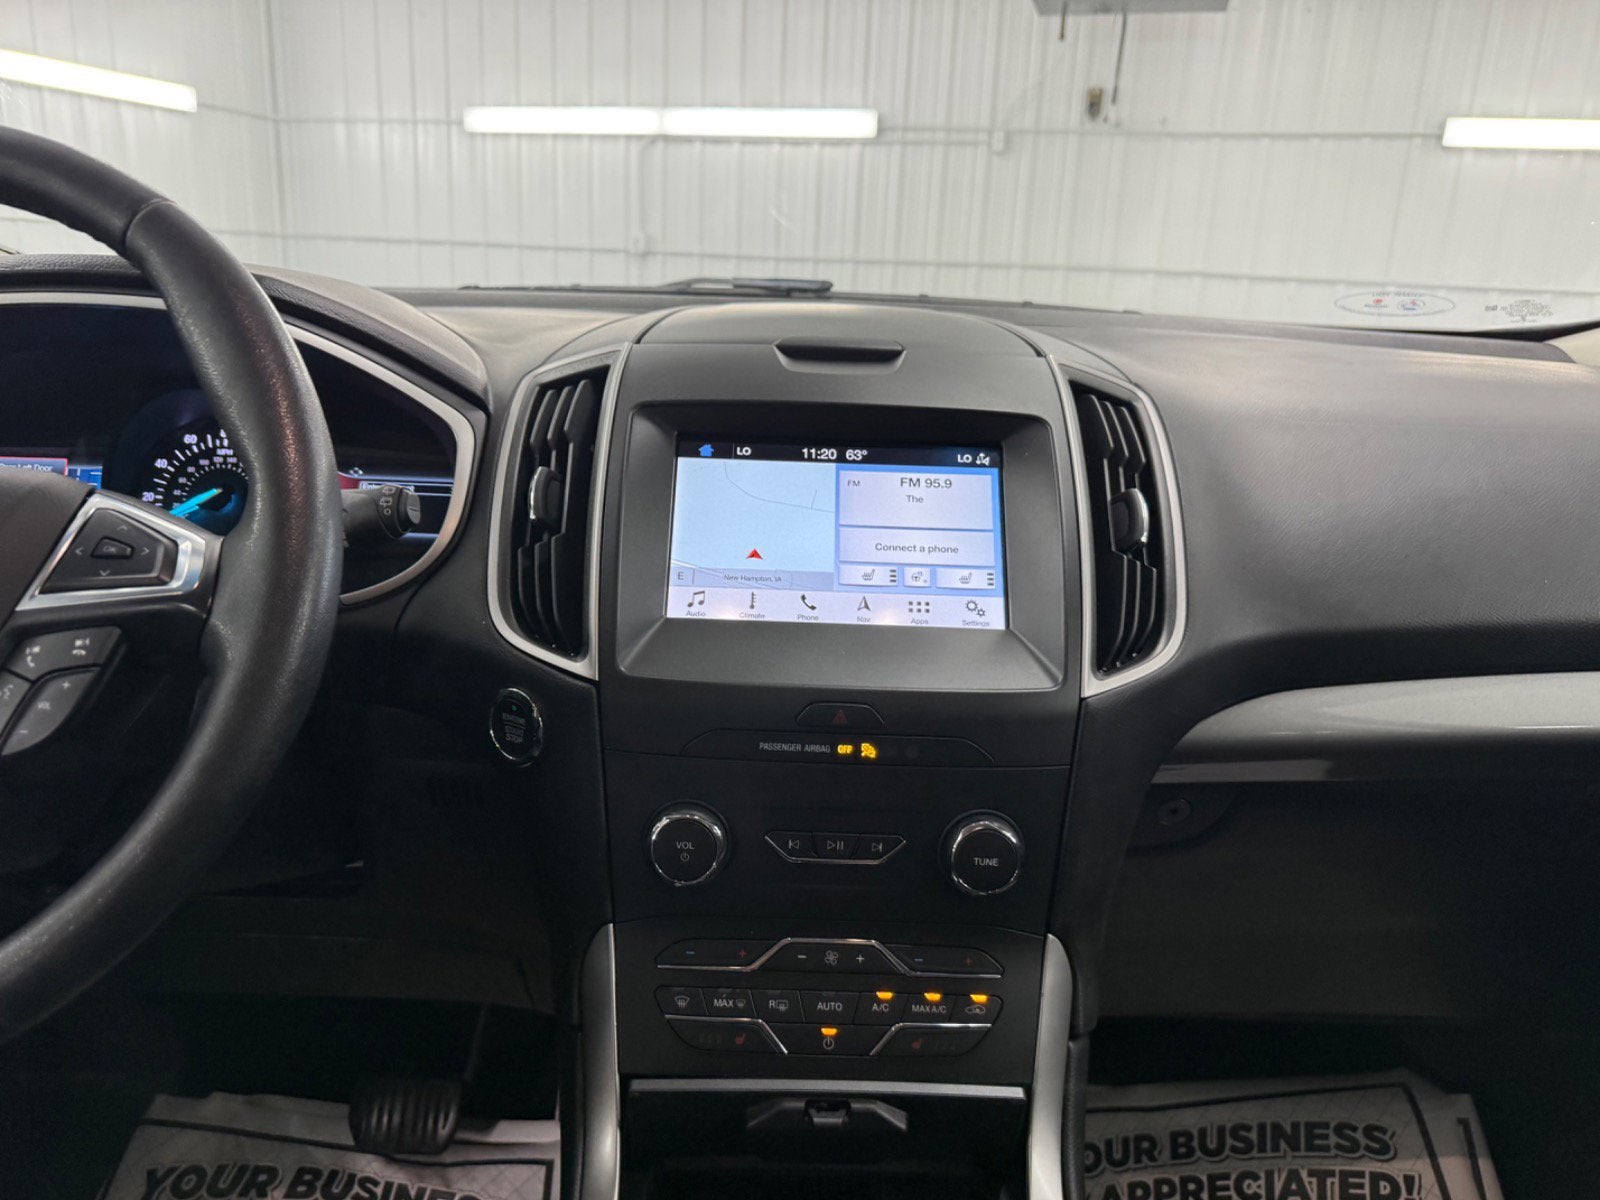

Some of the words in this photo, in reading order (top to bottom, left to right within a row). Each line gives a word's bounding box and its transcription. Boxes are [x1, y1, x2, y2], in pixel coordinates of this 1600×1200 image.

[183, 434, 198, 444] 60
[736, 446, 752, 456] LO
[802, 448, 837, 460] 11:20
[845, 449, 868, 461] 63°
[154, 458, 168, 468] 40
[957, 453, 972, 463] LO
[900, 477, 921, 488] FM
[924, 478, 953, 489] 95.9
[142, 491, 155, 502] 20
[905, 494, 924, 503] The
[875, 542, 917, 553] Connect
[919, 545, 926, 553] a
[928, 543, 959, 556] phone
[677, 571, 685, 581] E
[723, 574, 739, 582] New
[739, 611, 765, 620] Climate
[797, 614, 819, 622] Phone
[910, 618, 929, 626] Apps
[962, 619, 990, 628] Settings
[759, 742, 802, 752] PASSENGER
[803, 744, 831, 753] AIRBAG
[837, 744, 853, 754] OFF
[676, 841, 695, 850] VOL
[973, 857, 999, 867] TUNE
[713, 998, 734, 1008] MAX
[817, 1002, 843, 1012] AUTO
[872, 1003, 889, 1012] A/C
[1084, 1133, 1158, 1174] OUR
[1170, 1120, 1393, 1161] BUSINESS
[141, 1163, 280, 1200] YOUR
